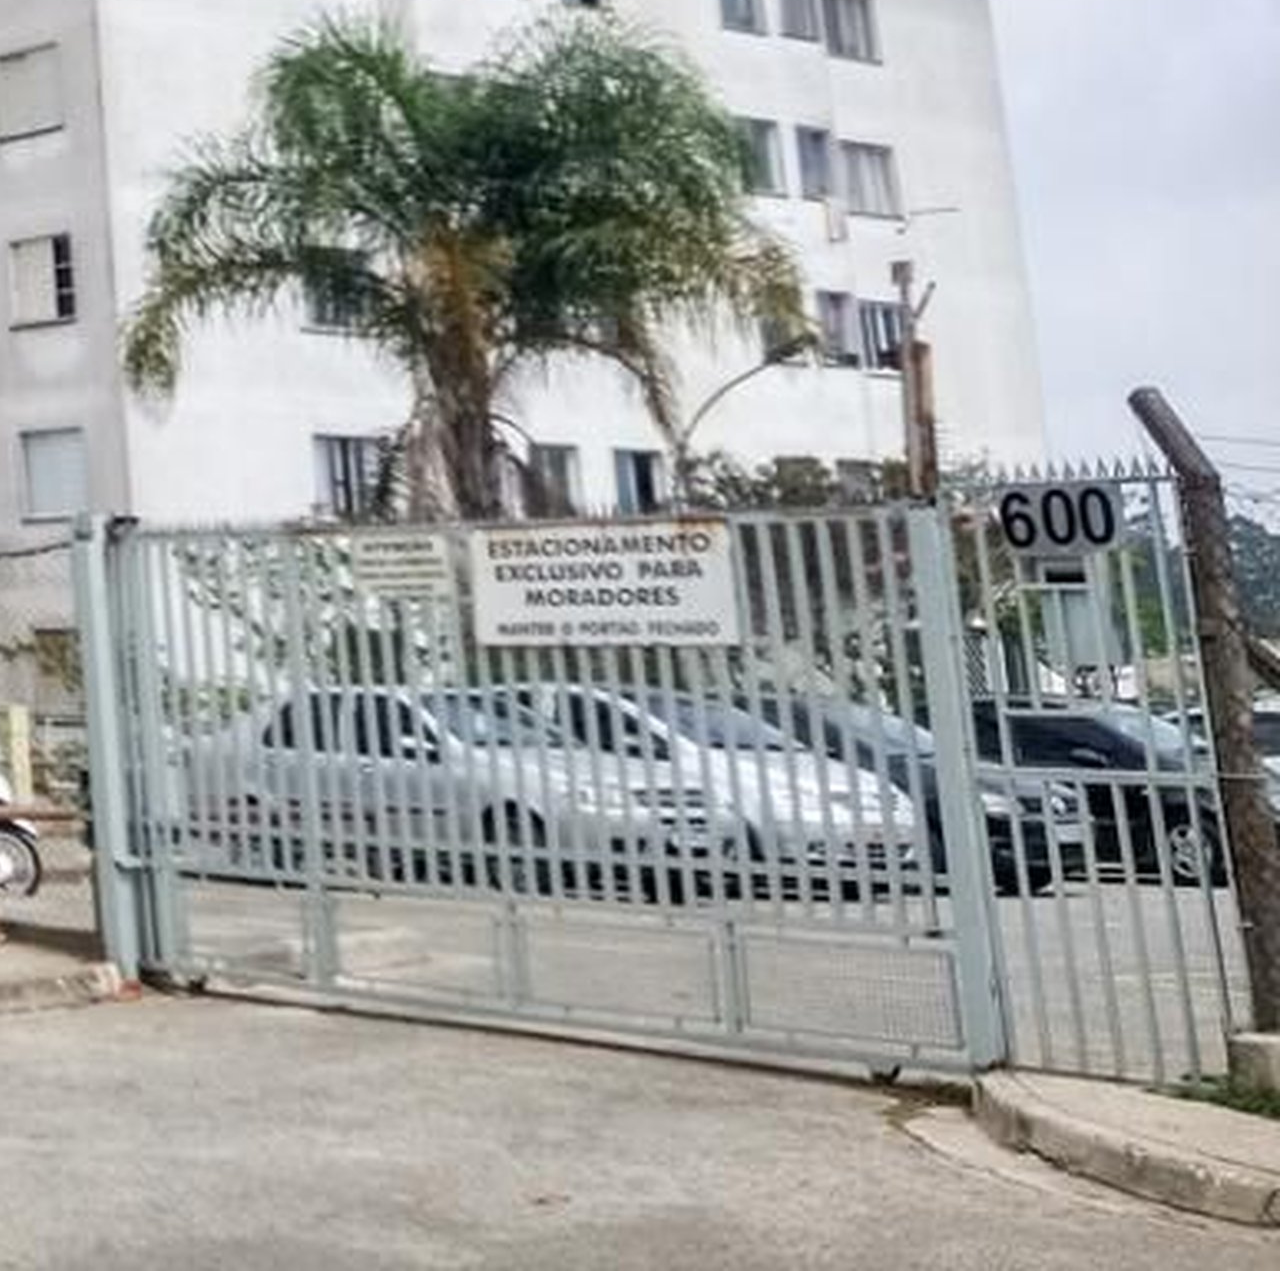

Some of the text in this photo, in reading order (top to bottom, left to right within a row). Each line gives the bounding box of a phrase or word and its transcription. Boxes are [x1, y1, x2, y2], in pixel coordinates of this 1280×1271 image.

[1000, 487, 1114, 547] 600
[488, 532, 710, 559] ESTACIONAMENTO
[495, 559, 702, 583] EXCLUSIVO PARA
[525, 586, 680, 608] MORADORES
